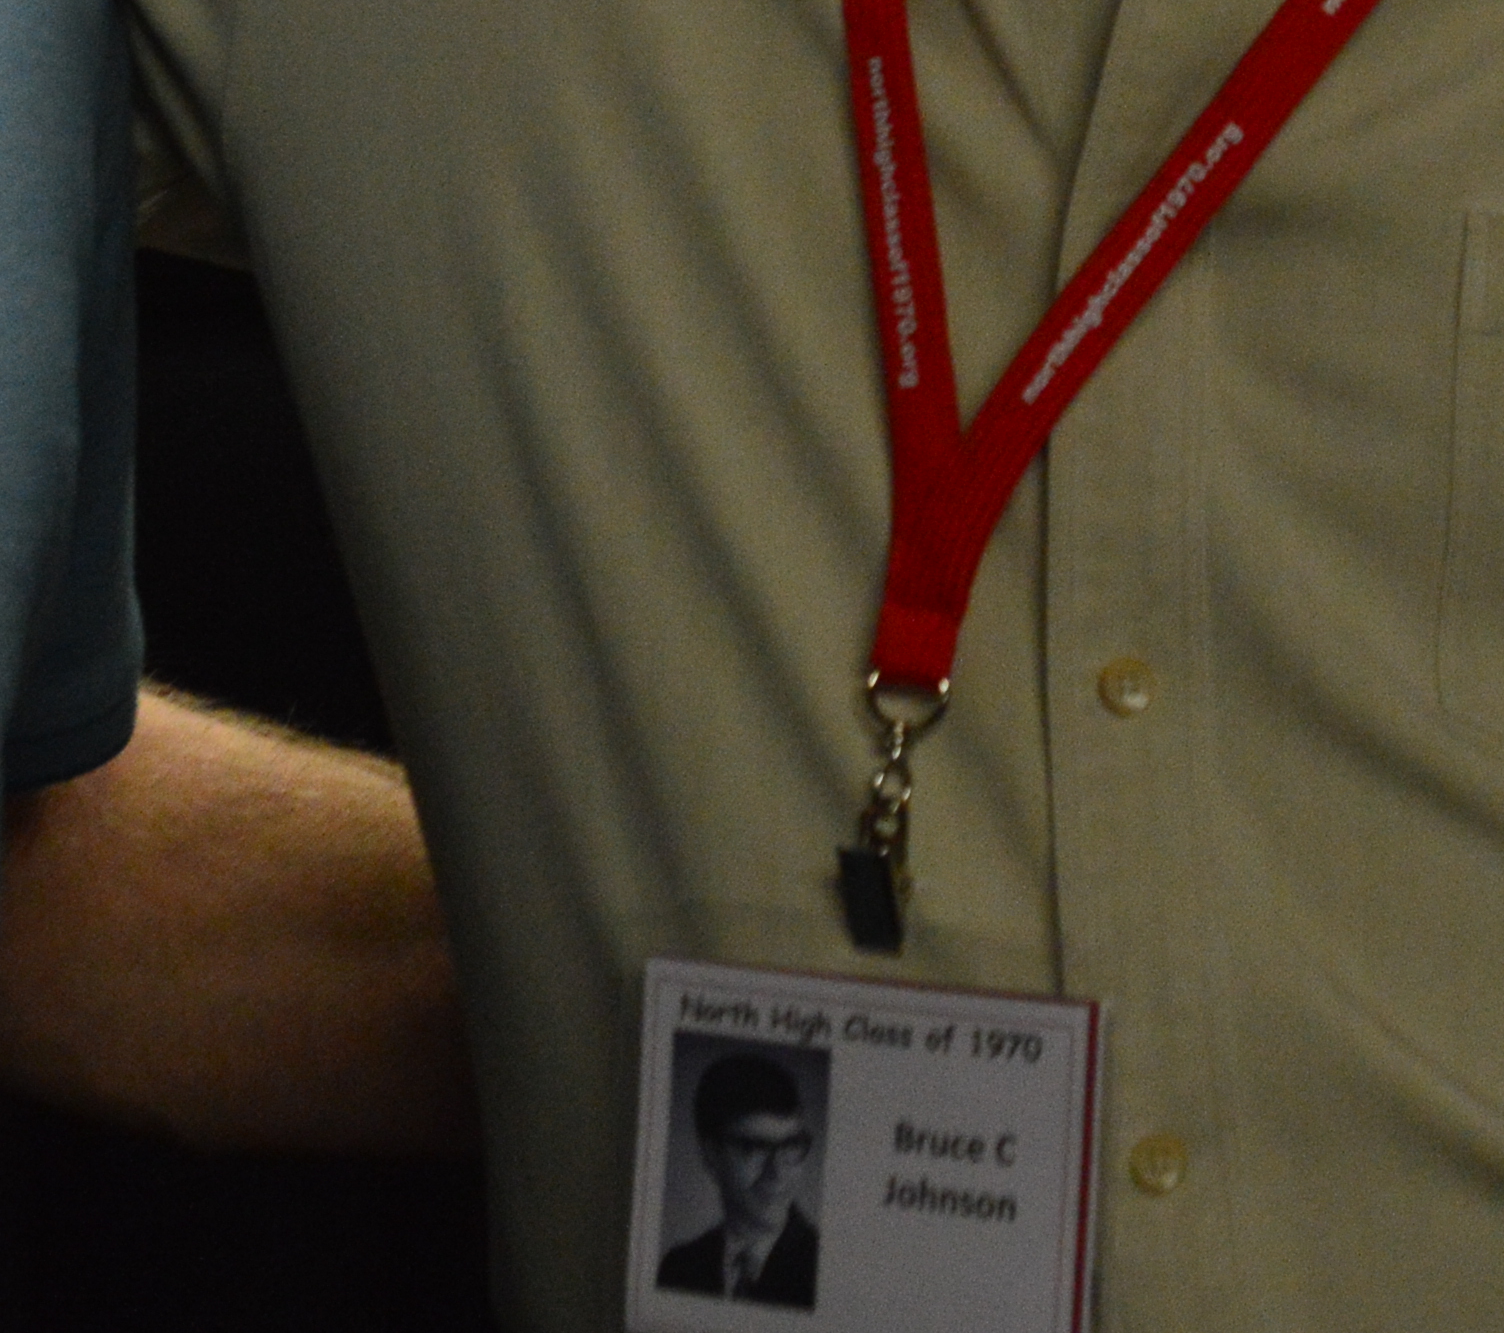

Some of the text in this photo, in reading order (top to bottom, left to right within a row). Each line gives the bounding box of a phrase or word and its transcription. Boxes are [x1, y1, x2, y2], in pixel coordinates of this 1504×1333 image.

[1021, 121, 1245, 405] northhighclassof1970.org
[679, 993, 1043, 1065] North High Class of 1970
[893, 1121, 1017, 1168] Bruce C
[883, 1174, 1018, 1225] Johnson
